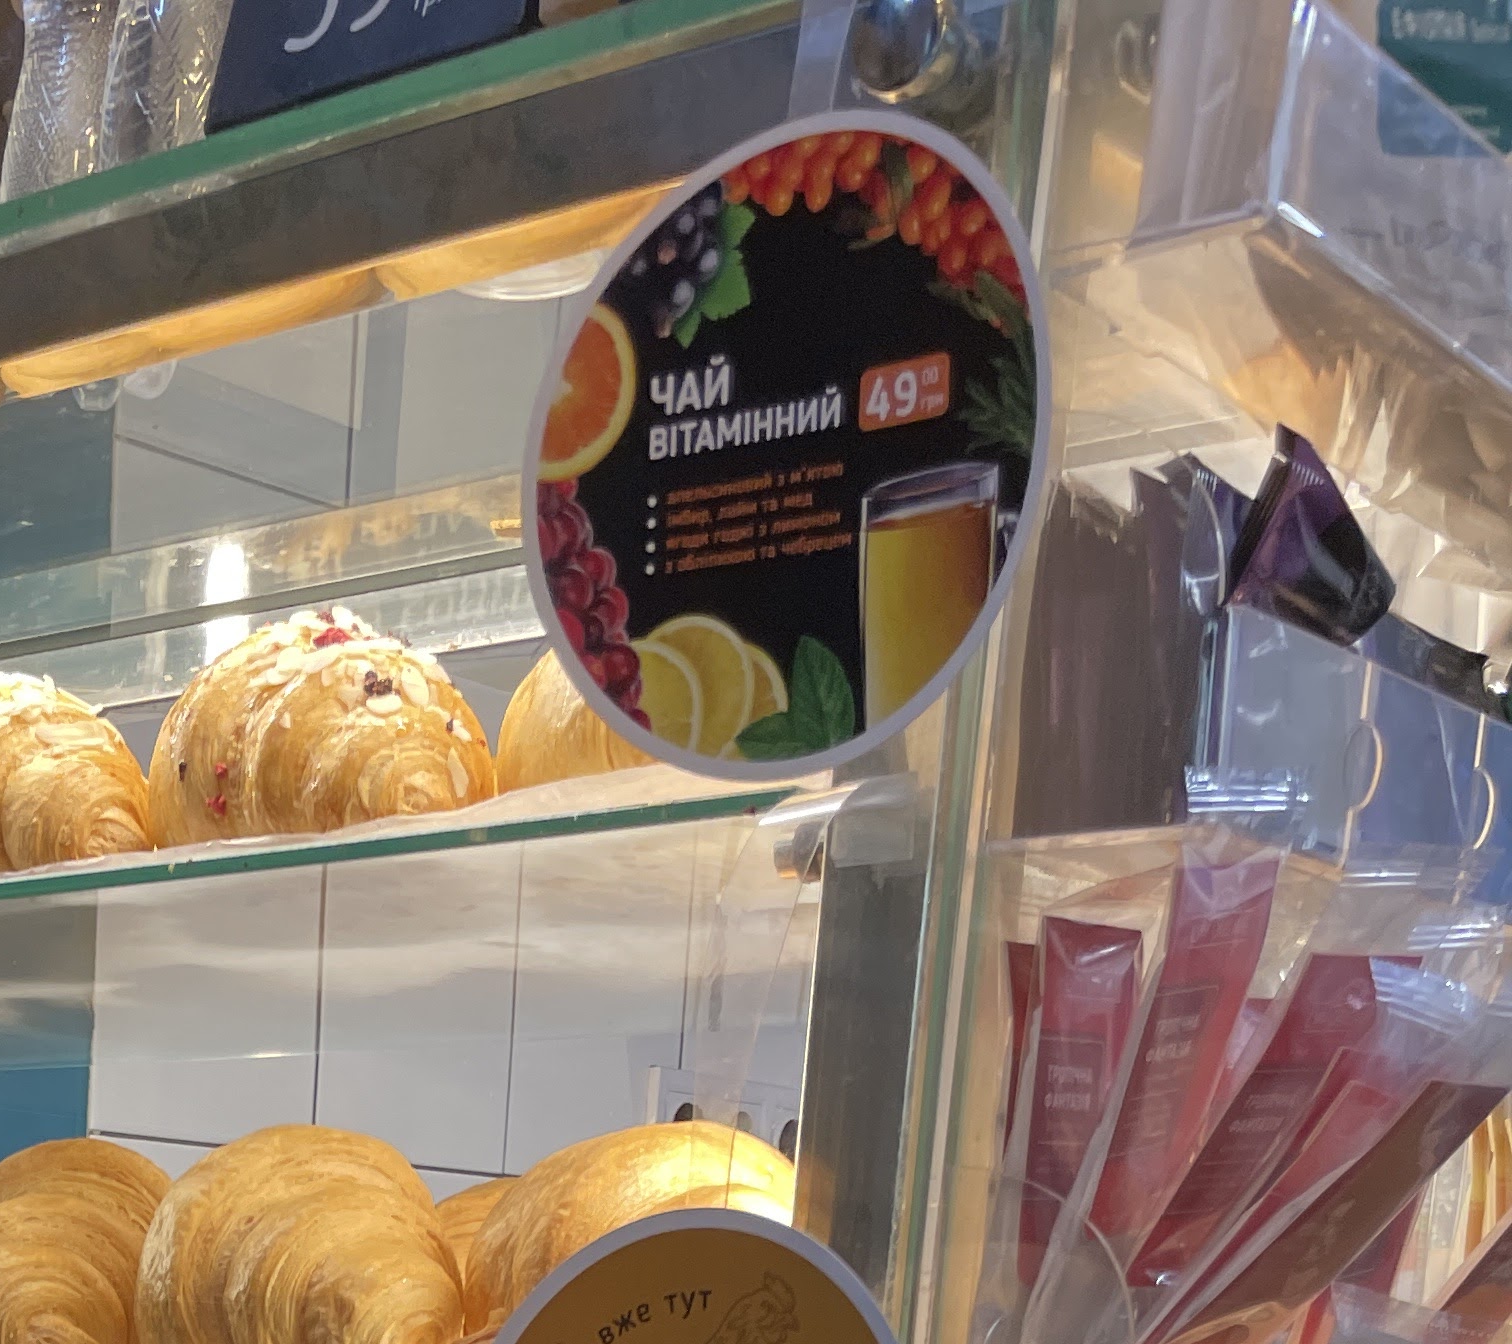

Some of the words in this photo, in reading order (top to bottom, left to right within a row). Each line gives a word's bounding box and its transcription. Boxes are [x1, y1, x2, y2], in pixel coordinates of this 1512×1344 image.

[648, 385, 842, 461] ВІТАМІННИЙ
[865, 370, 918, 421] 49
[650, 354, 731, 416] ЧАЙ
[664, 1290, 712, 1319] тут
